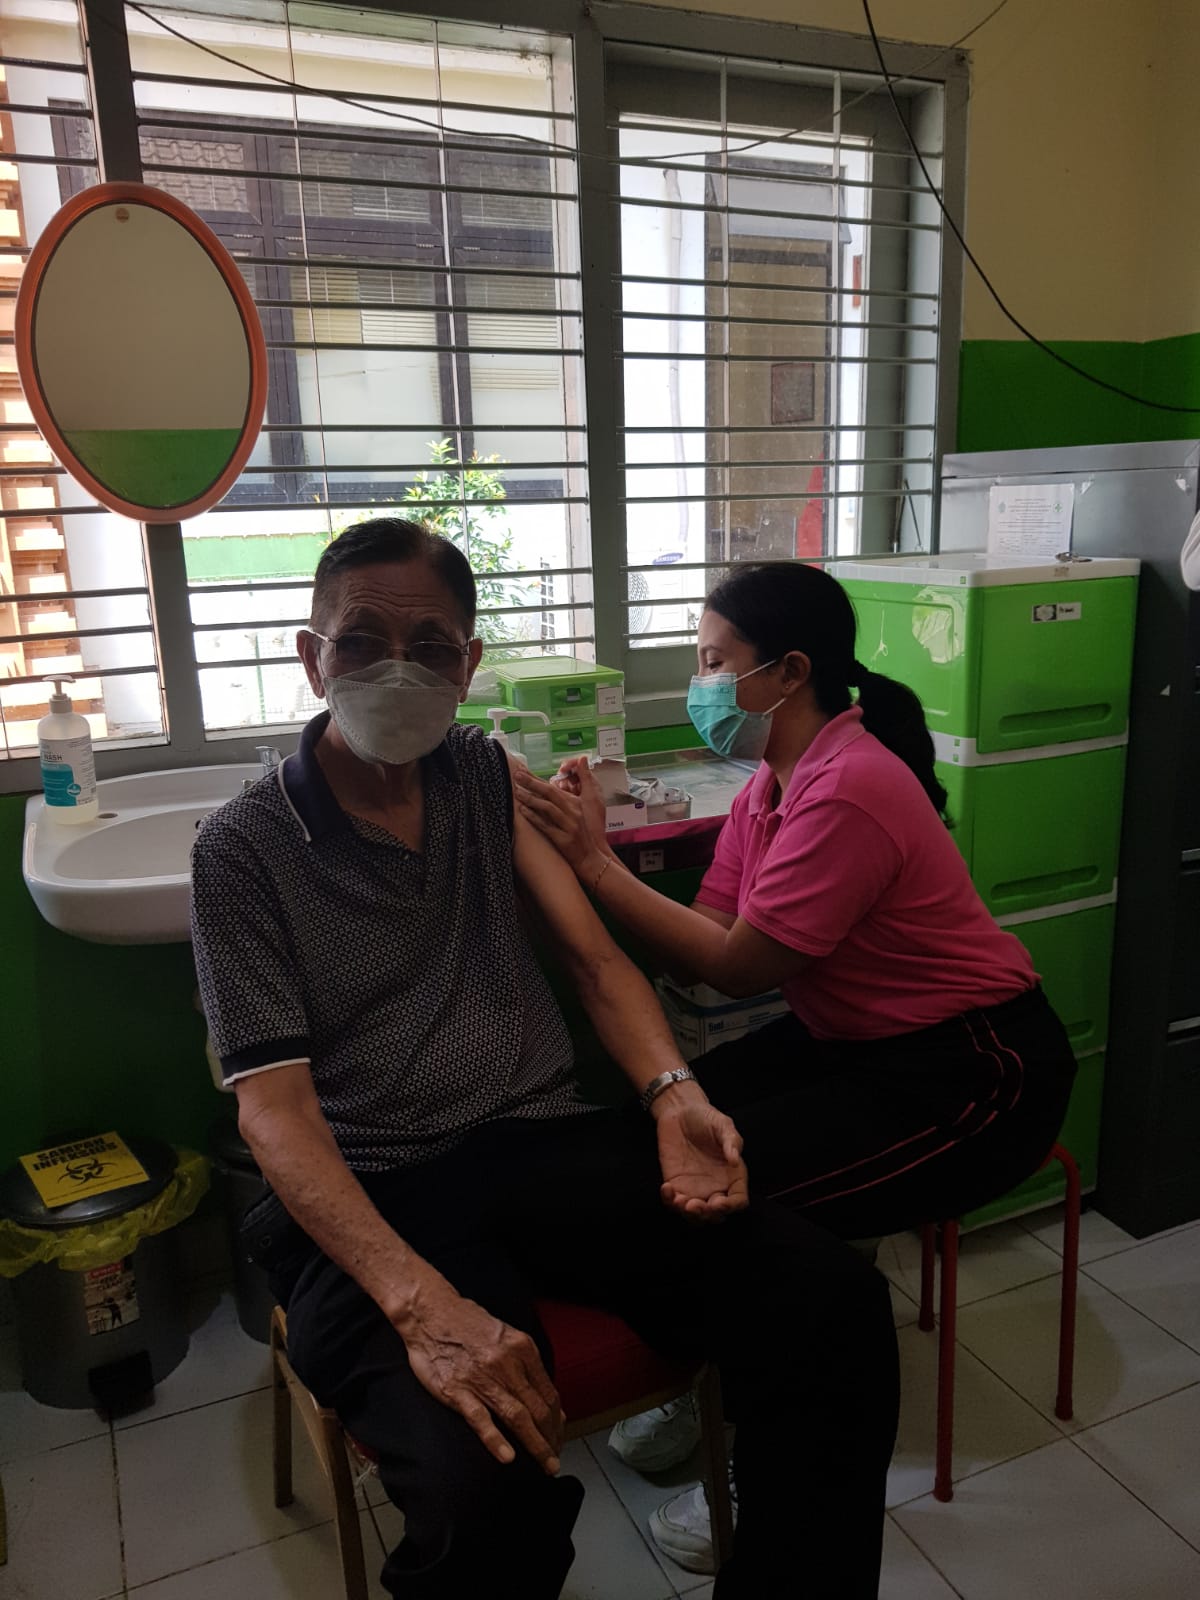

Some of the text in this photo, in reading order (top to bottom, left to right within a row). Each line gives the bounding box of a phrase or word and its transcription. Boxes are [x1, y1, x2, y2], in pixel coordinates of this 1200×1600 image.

[655, 554, 680, 563] SAMSUNG
[33, 1142, 118, 1170] INFEKSIUS
[37, 1137, 105, 1160] SAMPAH
